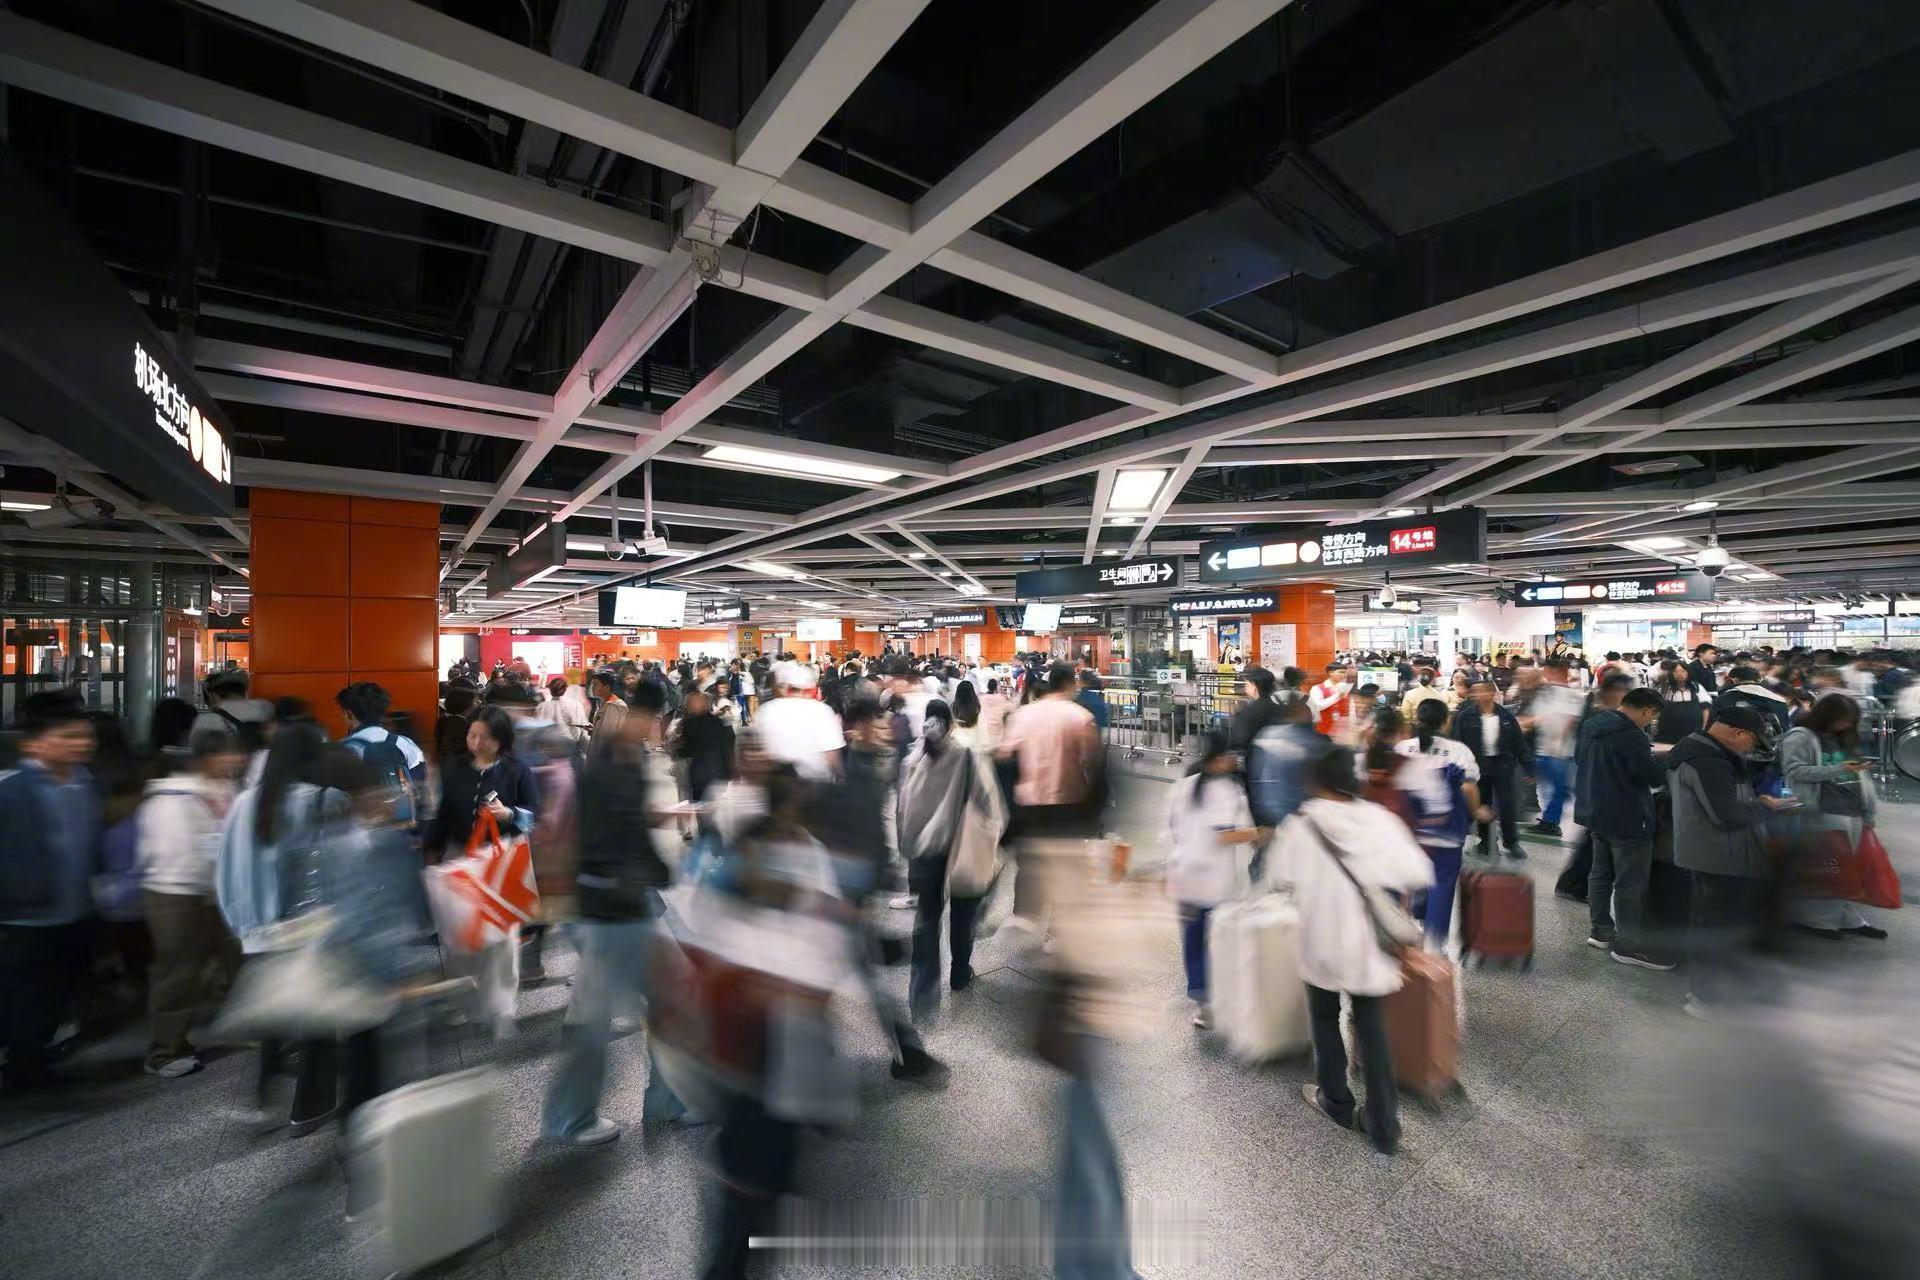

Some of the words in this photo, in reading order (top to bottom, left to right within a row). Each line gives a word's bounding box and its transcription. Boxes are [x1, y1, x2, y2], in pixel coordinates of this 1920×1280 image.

[1322, 545, 1388, 561] 体育西路方向
[1100, 568, 1126, 581] 卫生间
